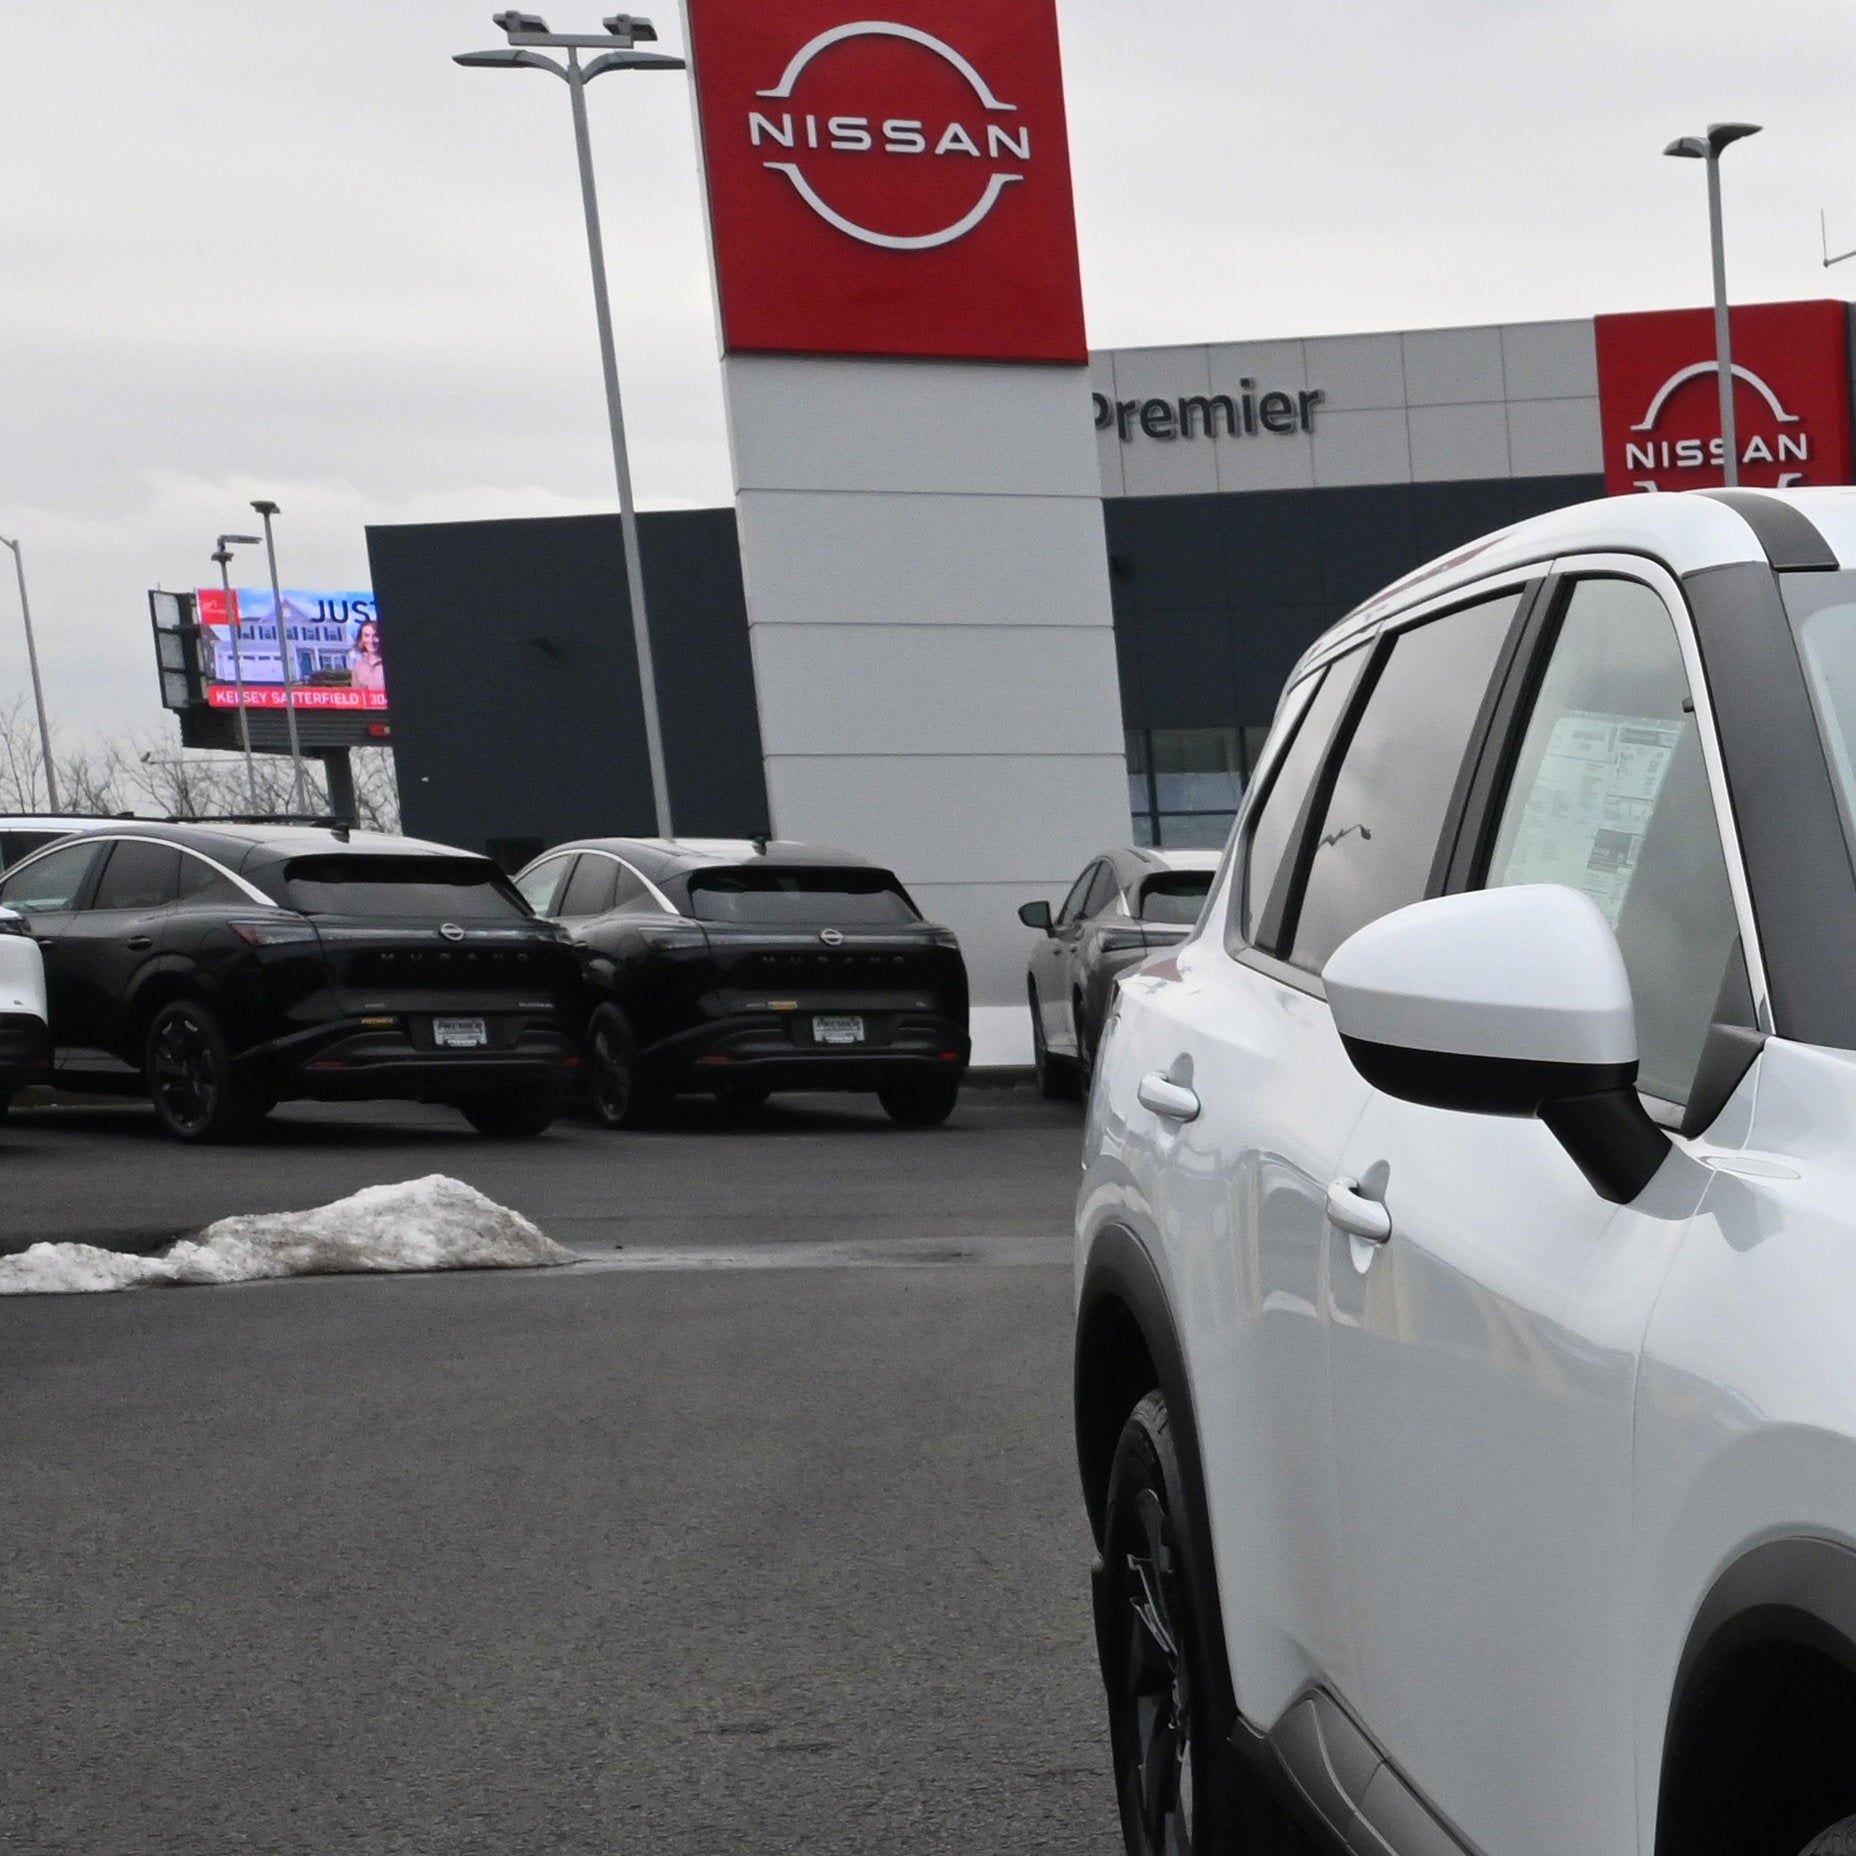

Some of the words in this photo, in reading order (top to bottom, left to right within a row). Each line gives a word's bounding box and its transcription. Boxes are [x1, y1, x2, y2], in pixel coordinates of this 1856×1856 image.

[749, 112, 1031, 160] NISSAN
[1625, 433, 1808, 469] NISSAN
[310, 599, 377, 624] JUS
[369, 693, 387, 706] 30
